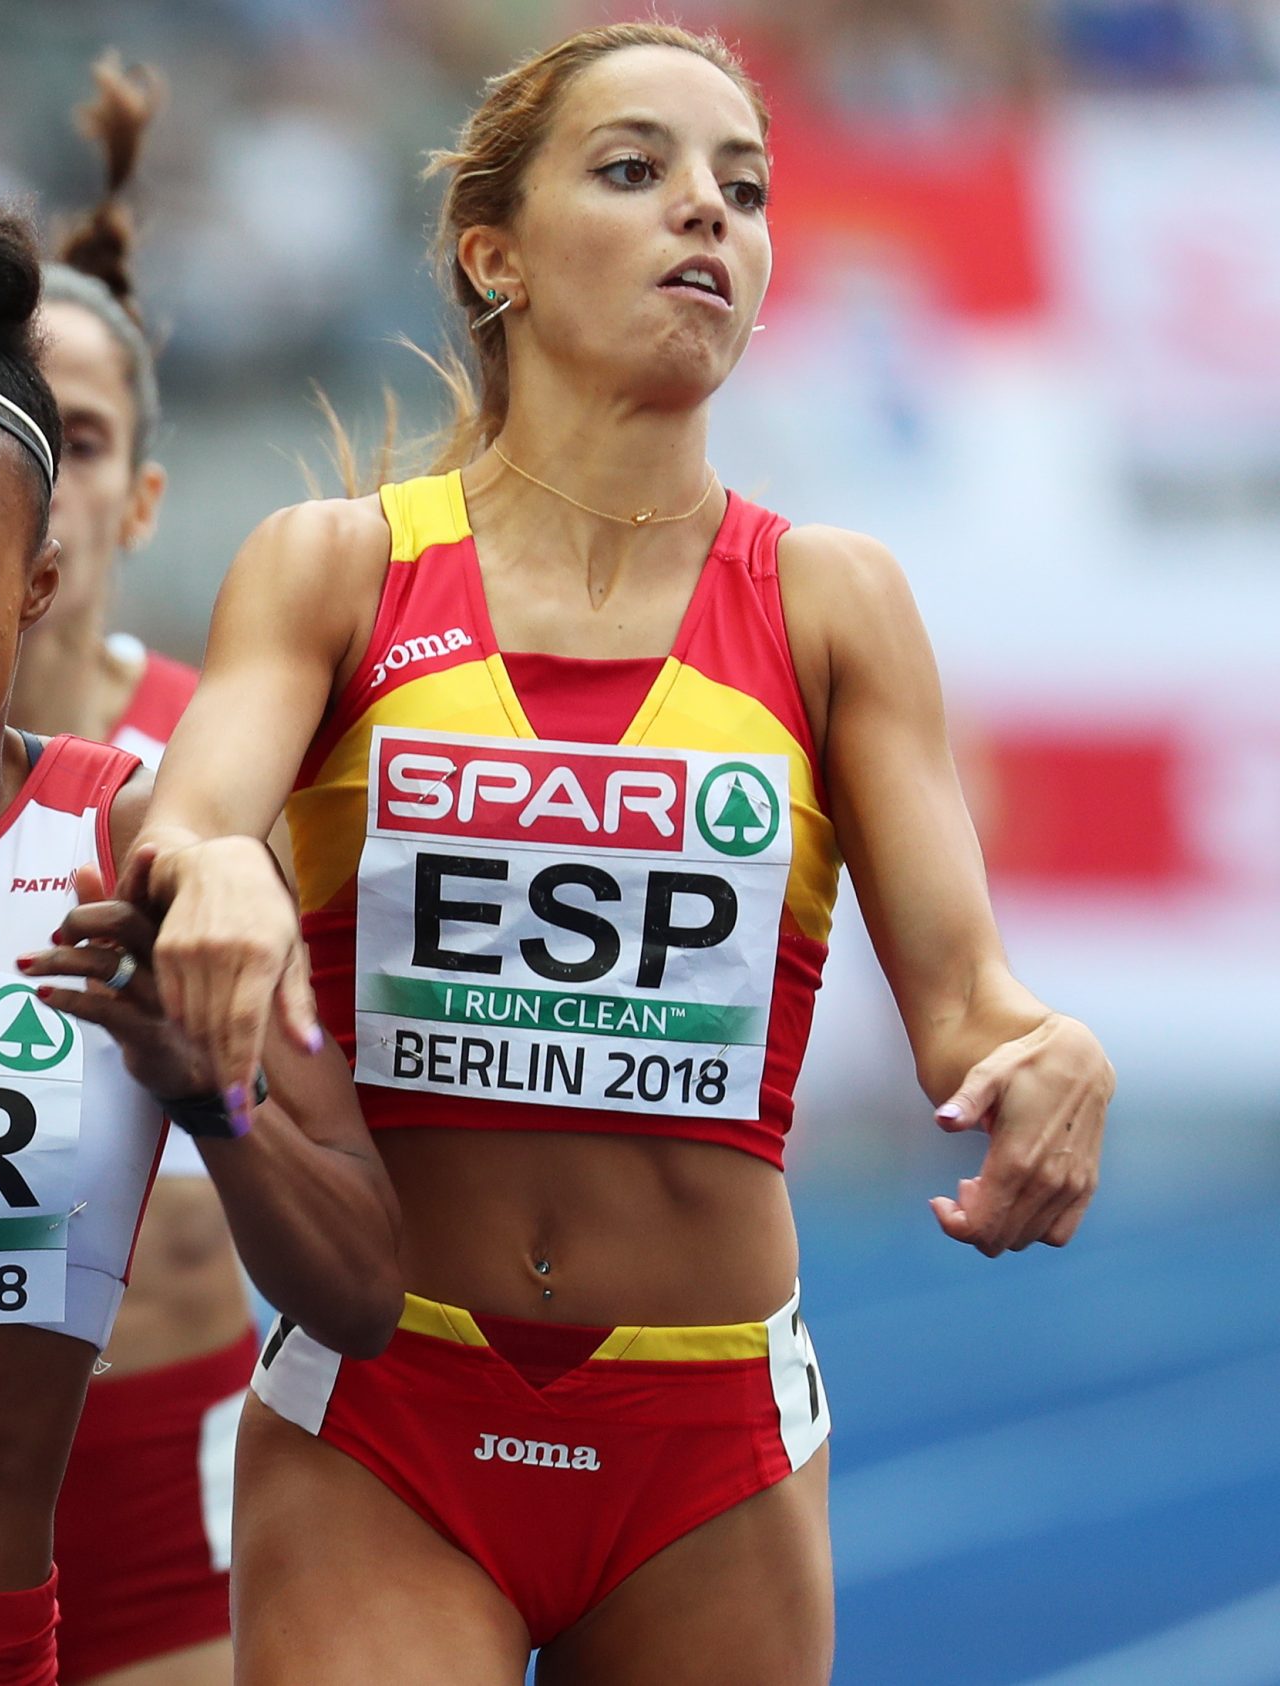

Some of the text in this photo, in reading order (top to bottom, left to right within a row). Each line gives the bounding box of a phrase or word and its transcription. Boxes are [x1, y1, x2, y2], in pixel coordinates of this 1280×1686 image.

[387, 752, 677, 838] SPAR
[411, 852, 738, 989] ESP
[443, 988, 453, 1017] I
[464, 991, 541, 1024] RUN
[393, 1029, 729, 1105] BERLIN 2018
[473, 1432, 601, 1472] Joma
